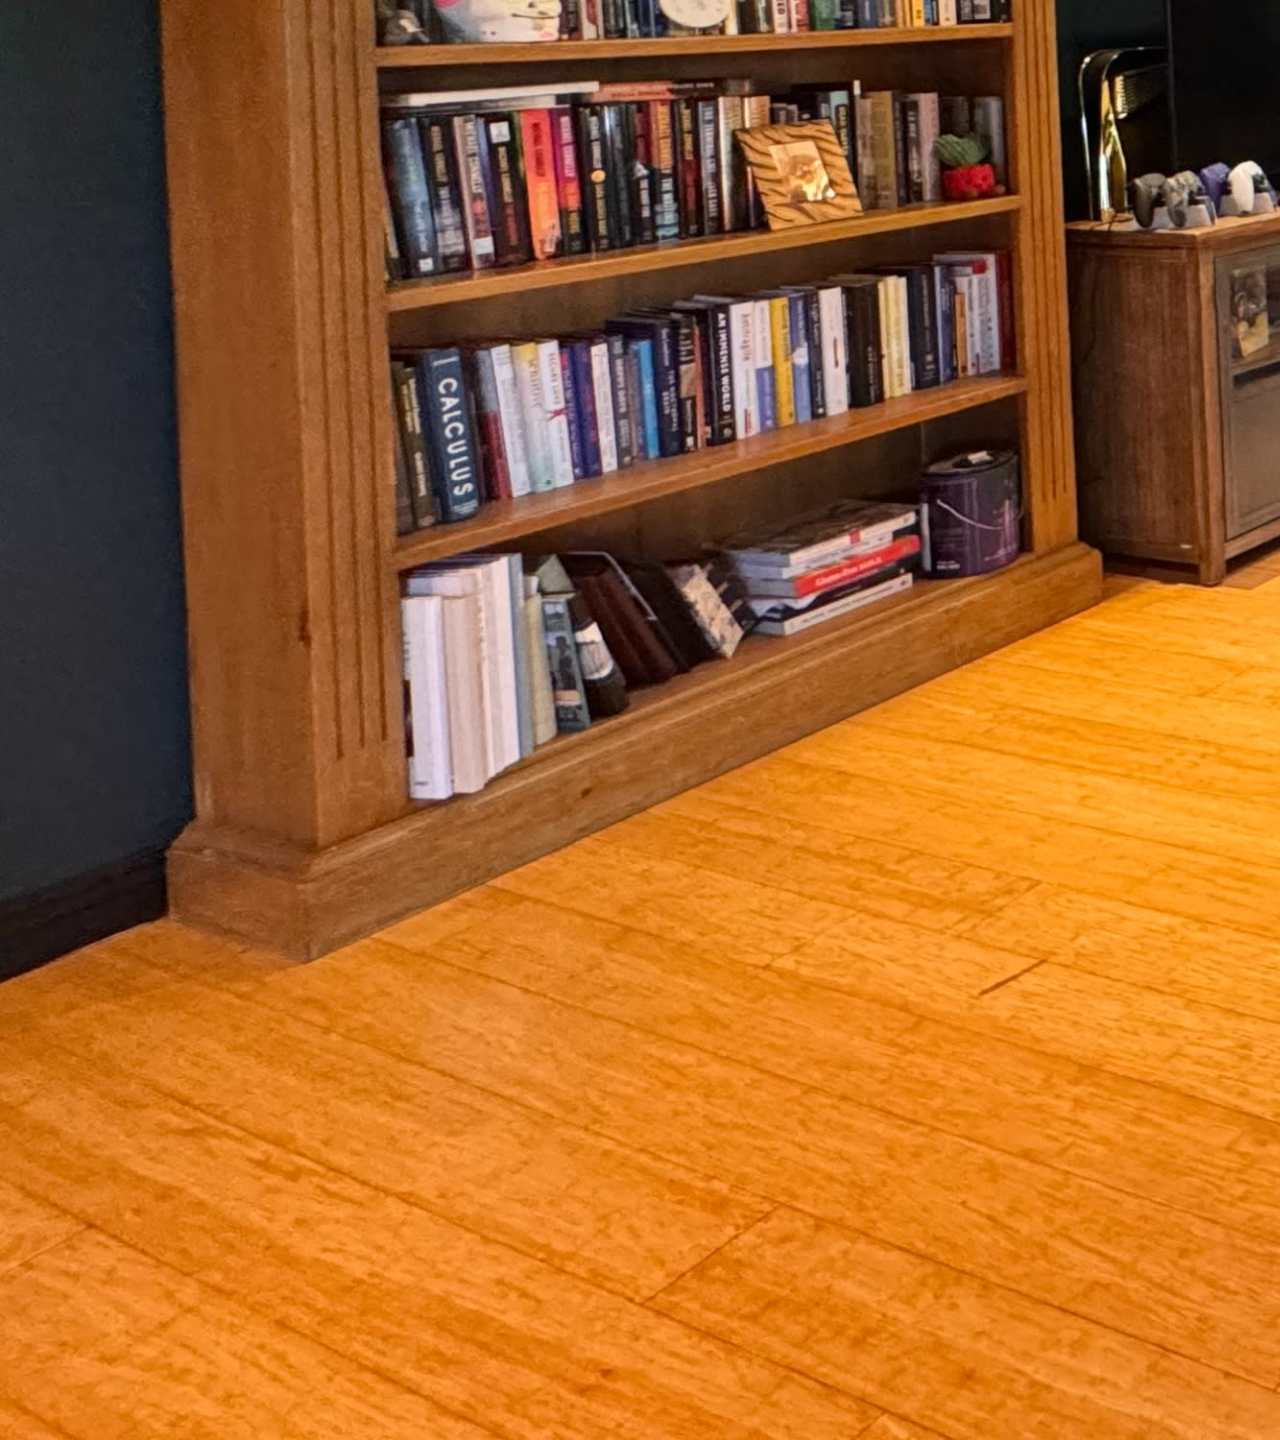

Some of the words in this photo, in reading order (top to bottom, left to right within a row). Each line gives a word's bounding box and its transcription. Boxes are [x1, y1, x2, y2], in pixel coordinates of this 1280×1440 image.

[718, 329, 730, 374] IMMENSE
[720, 375, 732, 412] WORLD
[438, 377, 474, 496] CALCULUS
